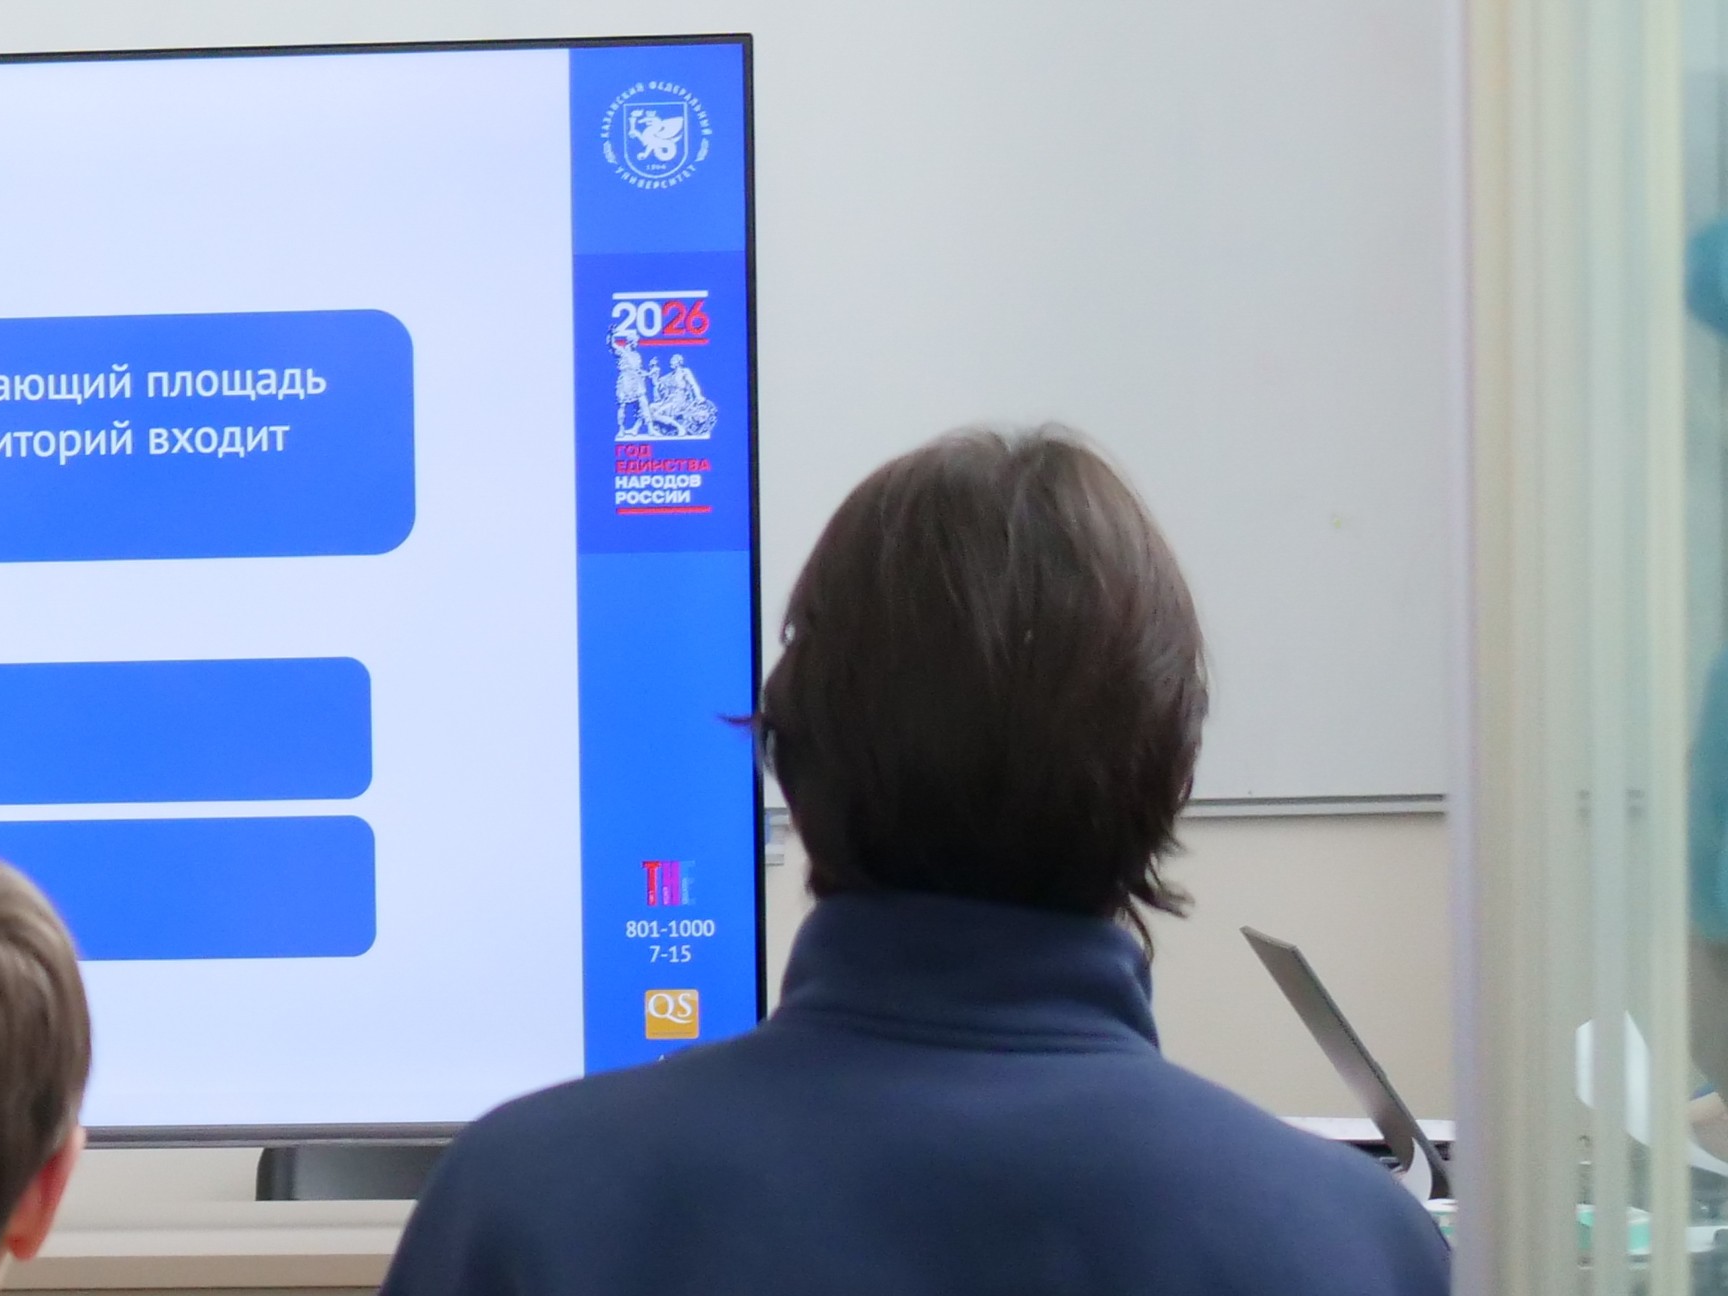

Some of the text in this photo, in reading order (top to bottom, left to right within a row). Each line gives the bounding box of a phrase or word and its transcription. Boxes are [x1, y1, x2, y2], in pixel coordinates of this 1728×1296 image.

[611, 300, 710, 337] 2026
[148, 369, 326, 400] площадь
[150, 426, 290, 458] входит
[615, 444, 651, 458] ГОД
[615, 459, 711, 473] ЕДИНСТВА
[615, 474, 701, 489] НАРОДОВ
[615, 490, 691, 504] РОССИИ
[626, 920, 715, 937] 801-1000
[650, 945, 691, 962] 7-15
[648, 992, 693, 1024] QS
